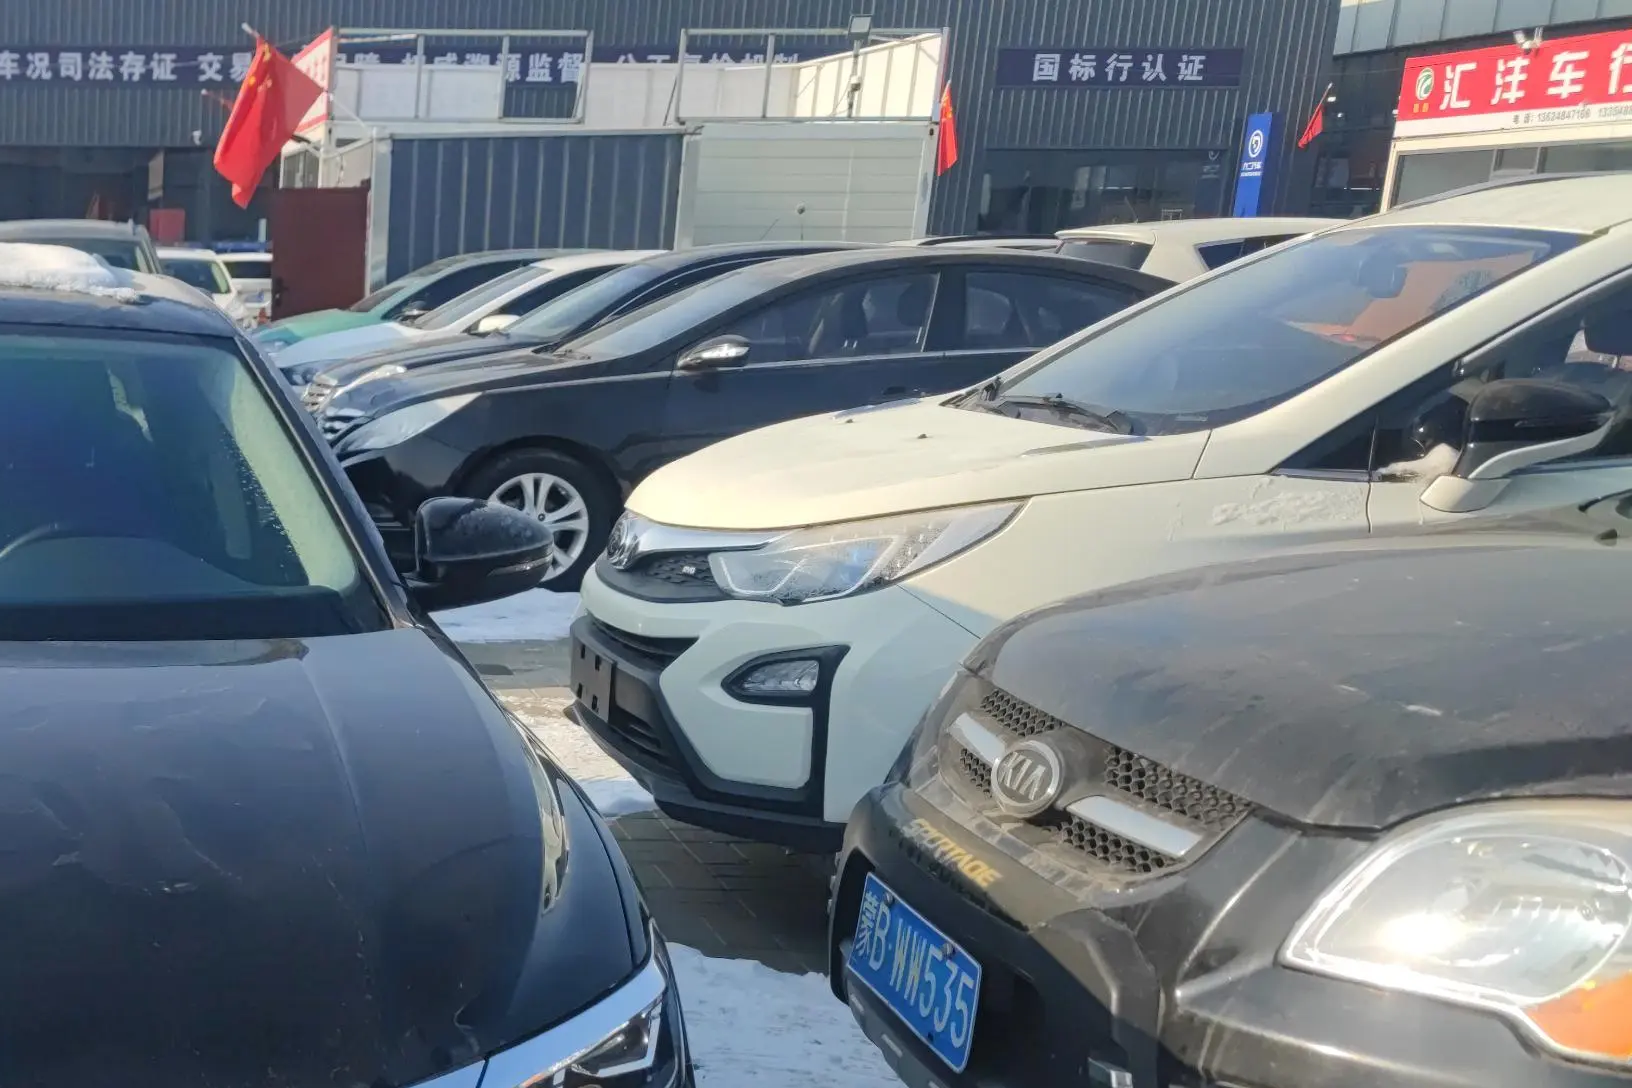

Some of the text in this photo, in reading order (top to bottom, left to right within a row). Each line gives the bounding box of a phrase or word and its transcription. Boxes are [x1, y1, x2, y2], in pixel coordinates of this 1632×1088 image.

[1032, 53, 1206, 82] 国标行认证
[998, 751, 1049, 801] KIA
